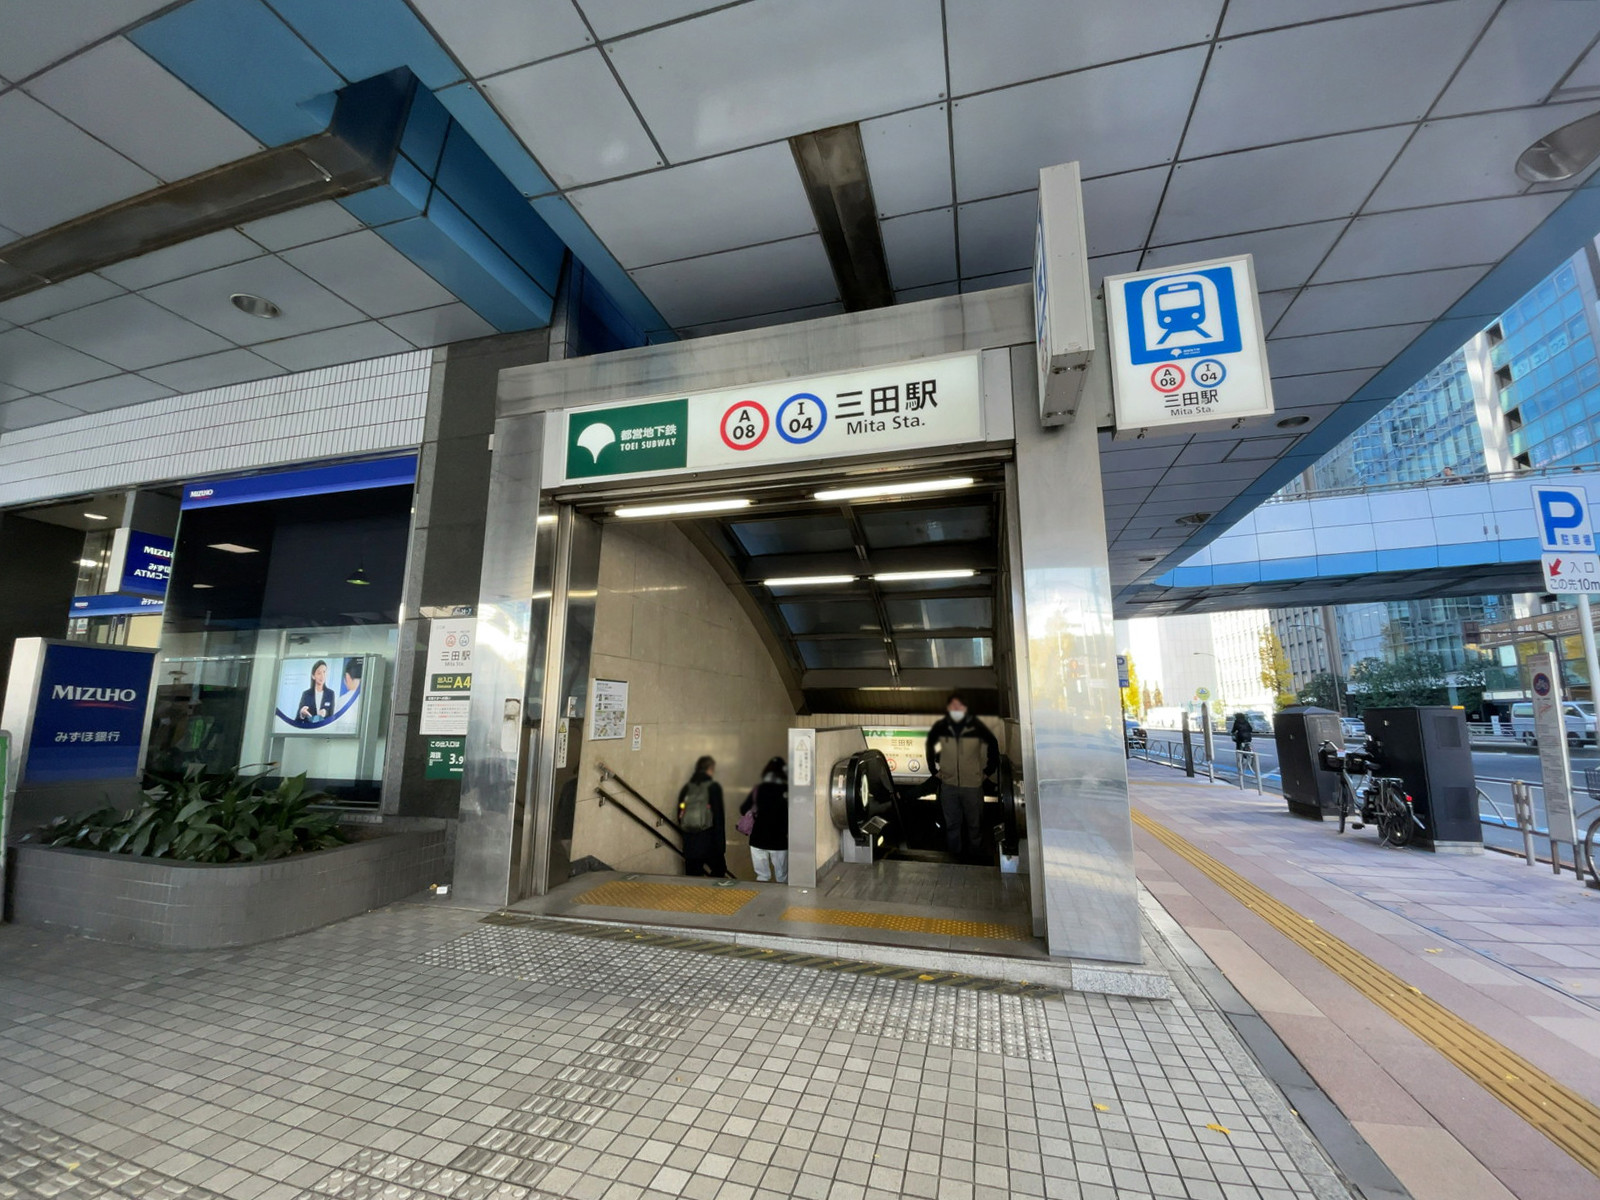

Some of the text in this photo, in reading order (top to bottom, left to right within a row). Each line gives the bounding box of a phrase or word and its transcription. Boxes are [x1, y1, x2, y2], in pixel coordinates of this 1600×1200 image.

[1163, 369, 1172, 377] A
[1205, 364, 1210, 372] I
[1160, 377, 1177, 387] 08
[1200, 372, 1217, 382] 04
[835, 379, 938, 420] 三田駅
[1164, 389, 1219, 408] 三田駅
[797, 402, 805, 416] I
[1170, 406, 1214, 416] Mita Sta.
[739, 410, 751, 423] A
[789, 417, 813, 434] 04
[847, 415, 925, 435] Mita Sta.
[620, 424, 677, 441] 都営地下鉄
[733, 424, 755, 440] 08
[620, 438, 677, 451] TOEI SUBWAY
[1538, 491, 1583, 545] P
[1570, 561, 1595, 573] 入口
[440, 651, 471, 661] 三田駅
[453, 676, 471, 689] A4
[51, 684, 137, 702] MIZUHO
[54, 731, 121, 743] みずほ銀行
